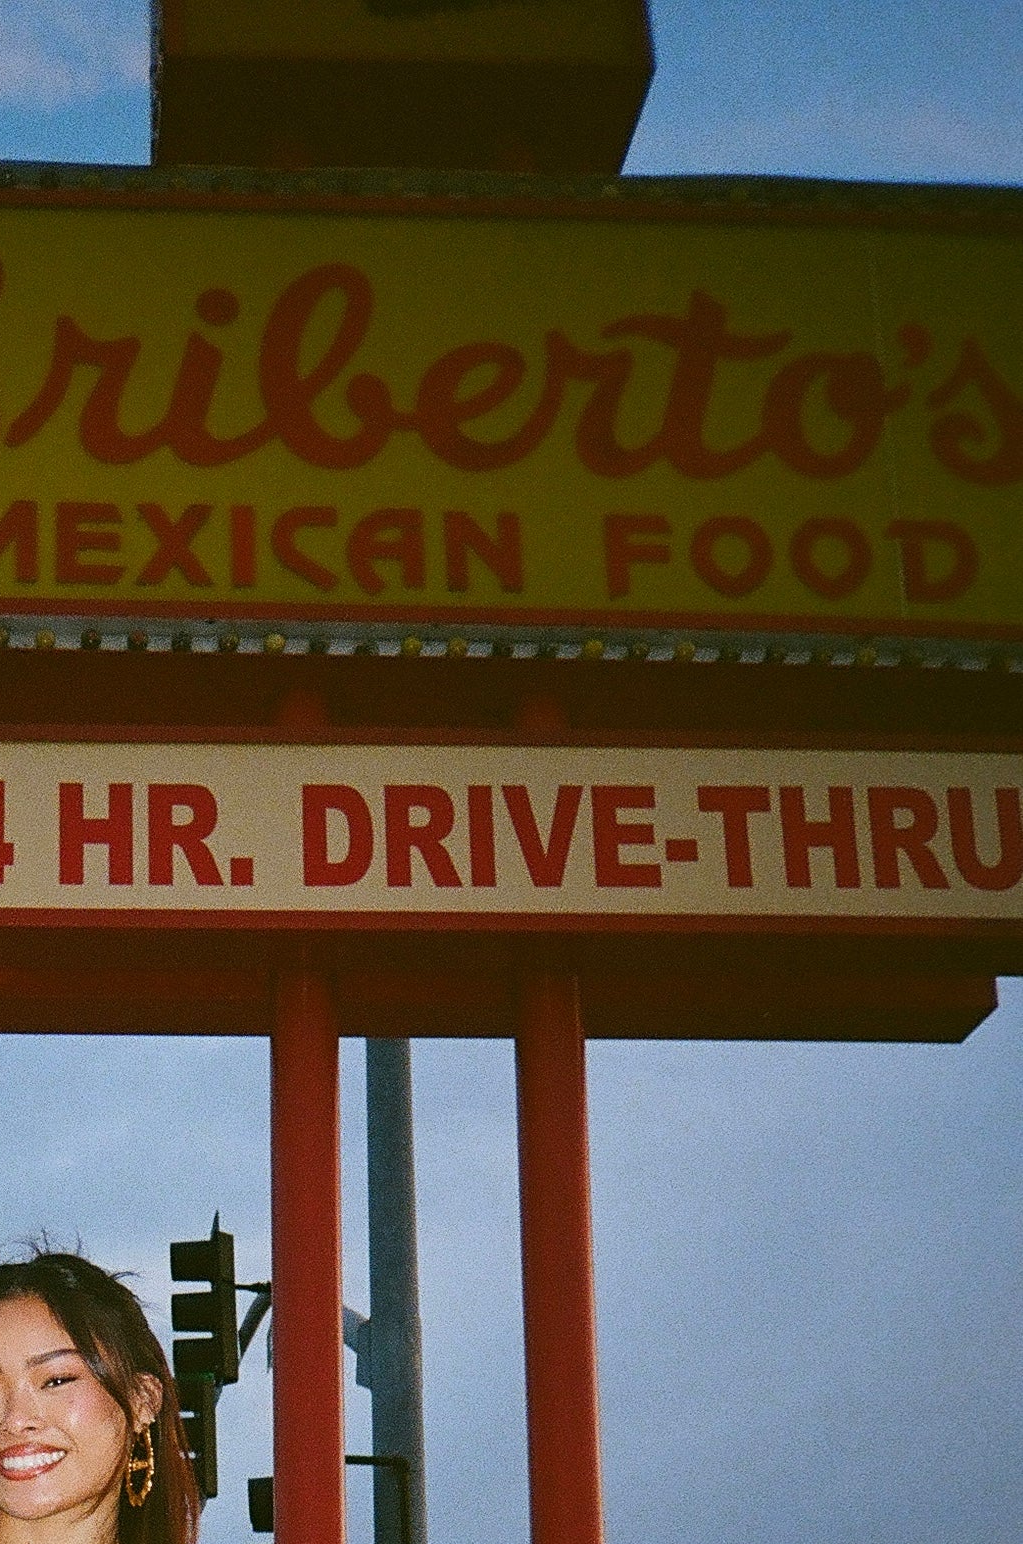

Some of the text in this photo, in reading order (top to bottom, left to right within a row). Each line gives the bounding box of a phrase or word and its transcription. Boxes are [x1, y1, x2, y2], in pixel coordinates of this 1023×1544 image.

[603, 513, 979, 604] FOOD
[58, 783, 254, 887] HR.
[302, 784, 1023, 892] DRIVE-THRU
